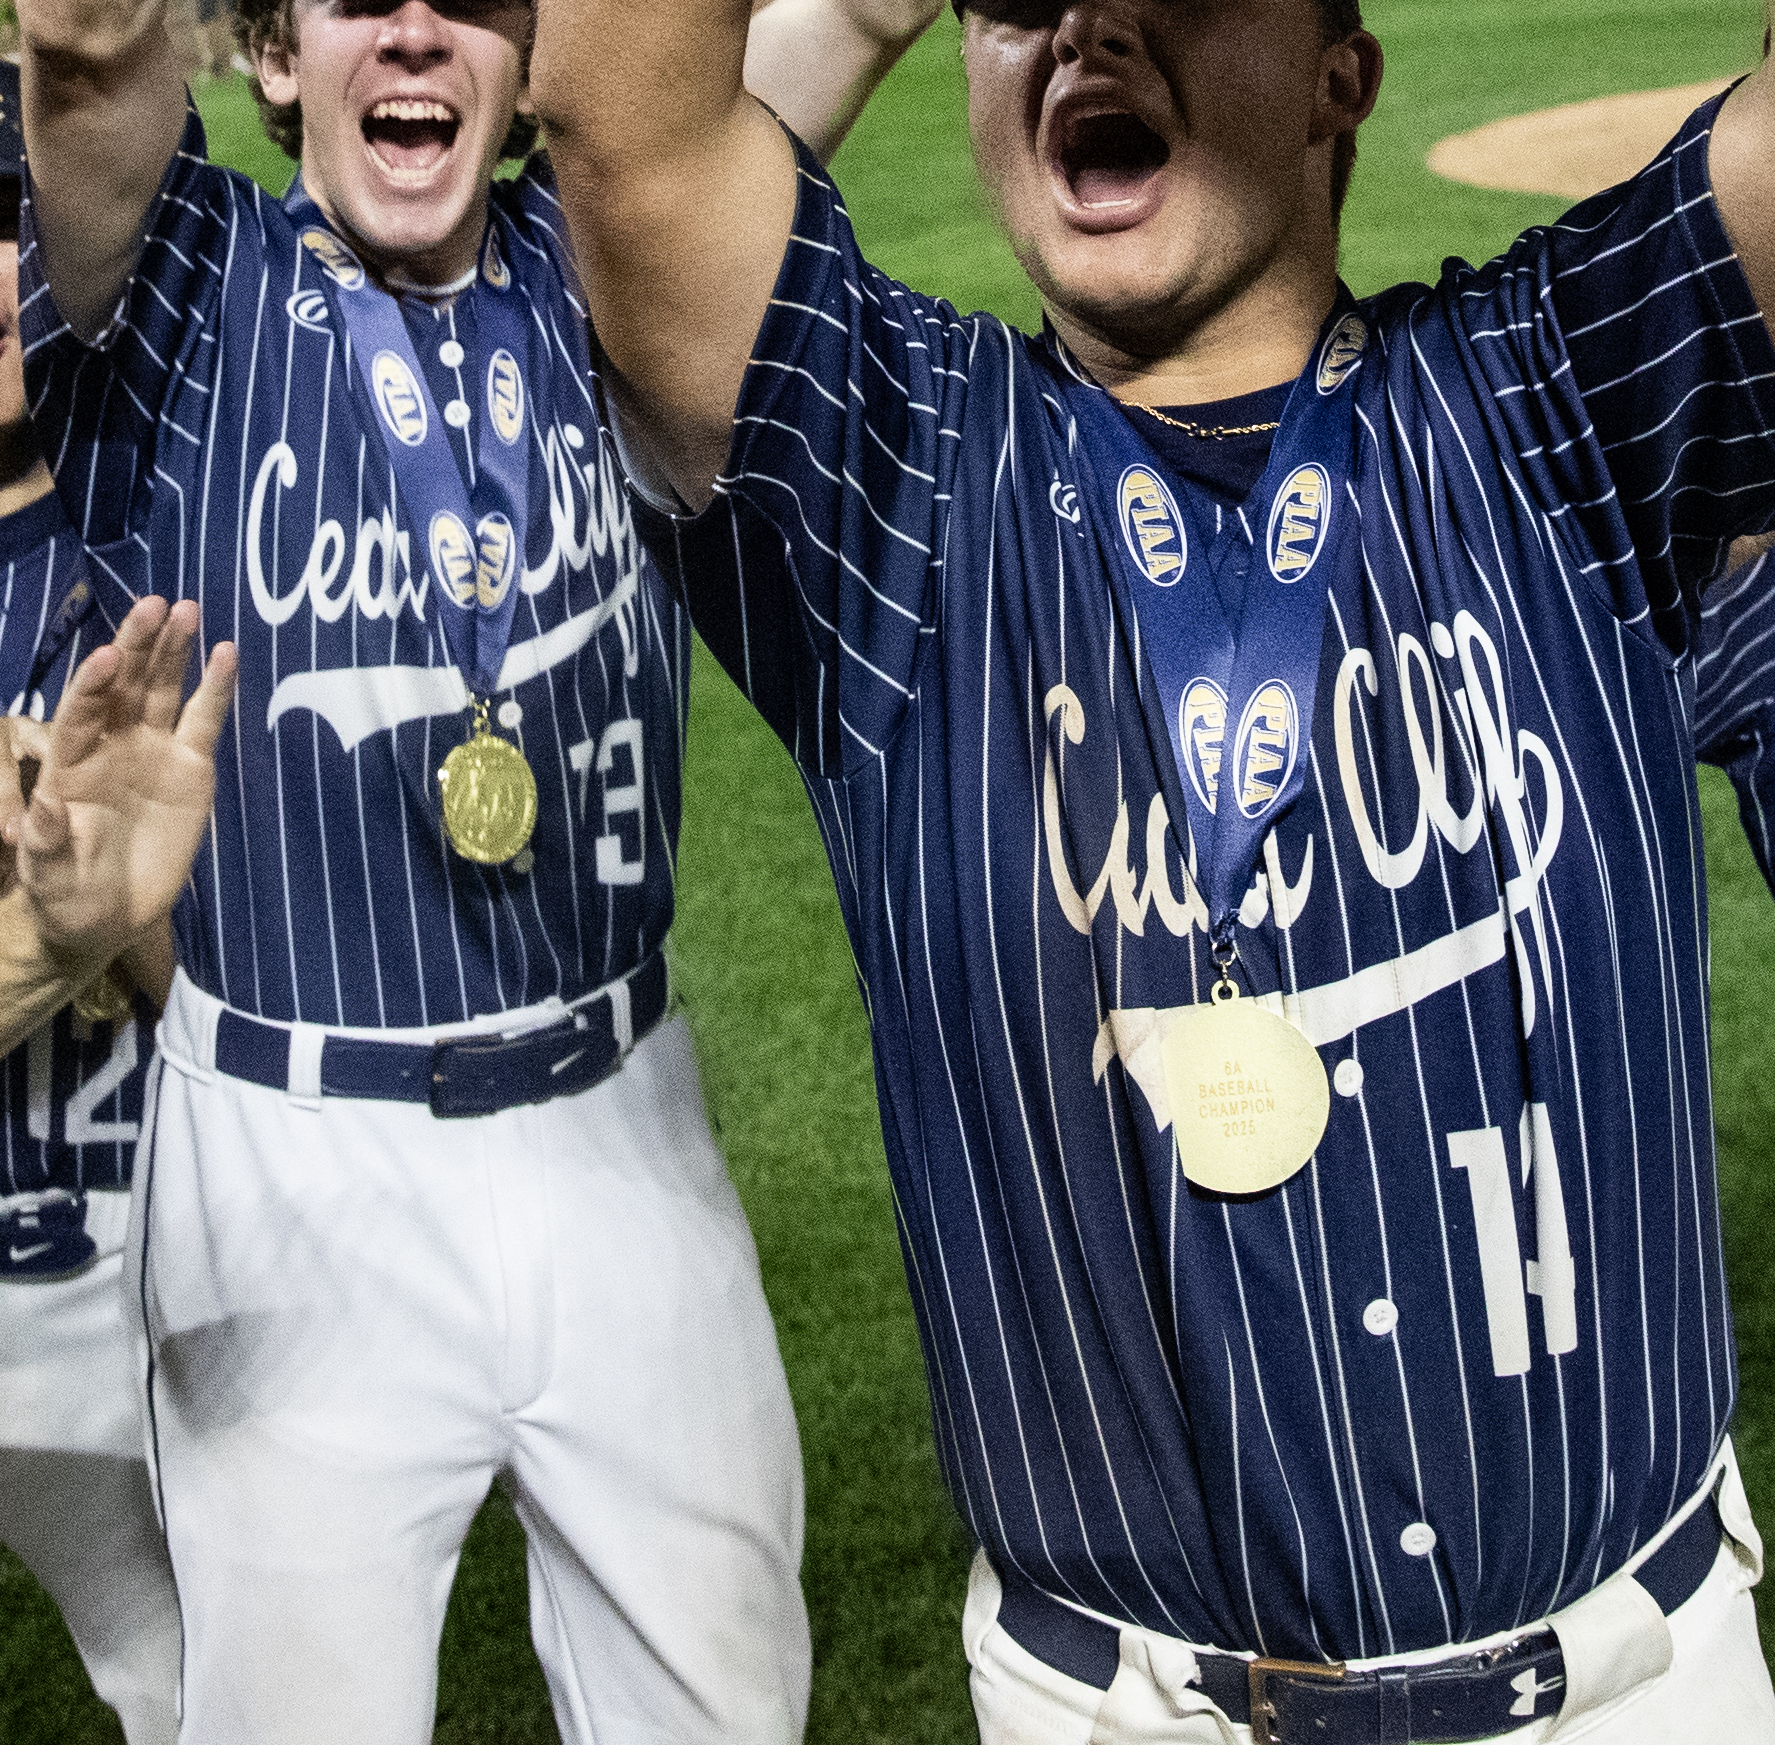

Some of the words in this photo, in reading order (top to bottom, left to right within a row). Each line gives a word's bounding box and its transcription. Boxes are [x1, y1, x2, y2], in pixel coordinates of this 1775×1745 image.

[1126, 478, 1182, 579] PIAA
[1274, 479, 1322, 574] PIAA
[1241, 701, 1288, 809] PIAA
[1223, 1060, 1243, 1076] 6A
[1197, 1078, 1273, 1099] BASEBALL
[1198, 1098, 1276, 1120] CHAMPION
[1222, 1119, 1257, 1138] 2025
